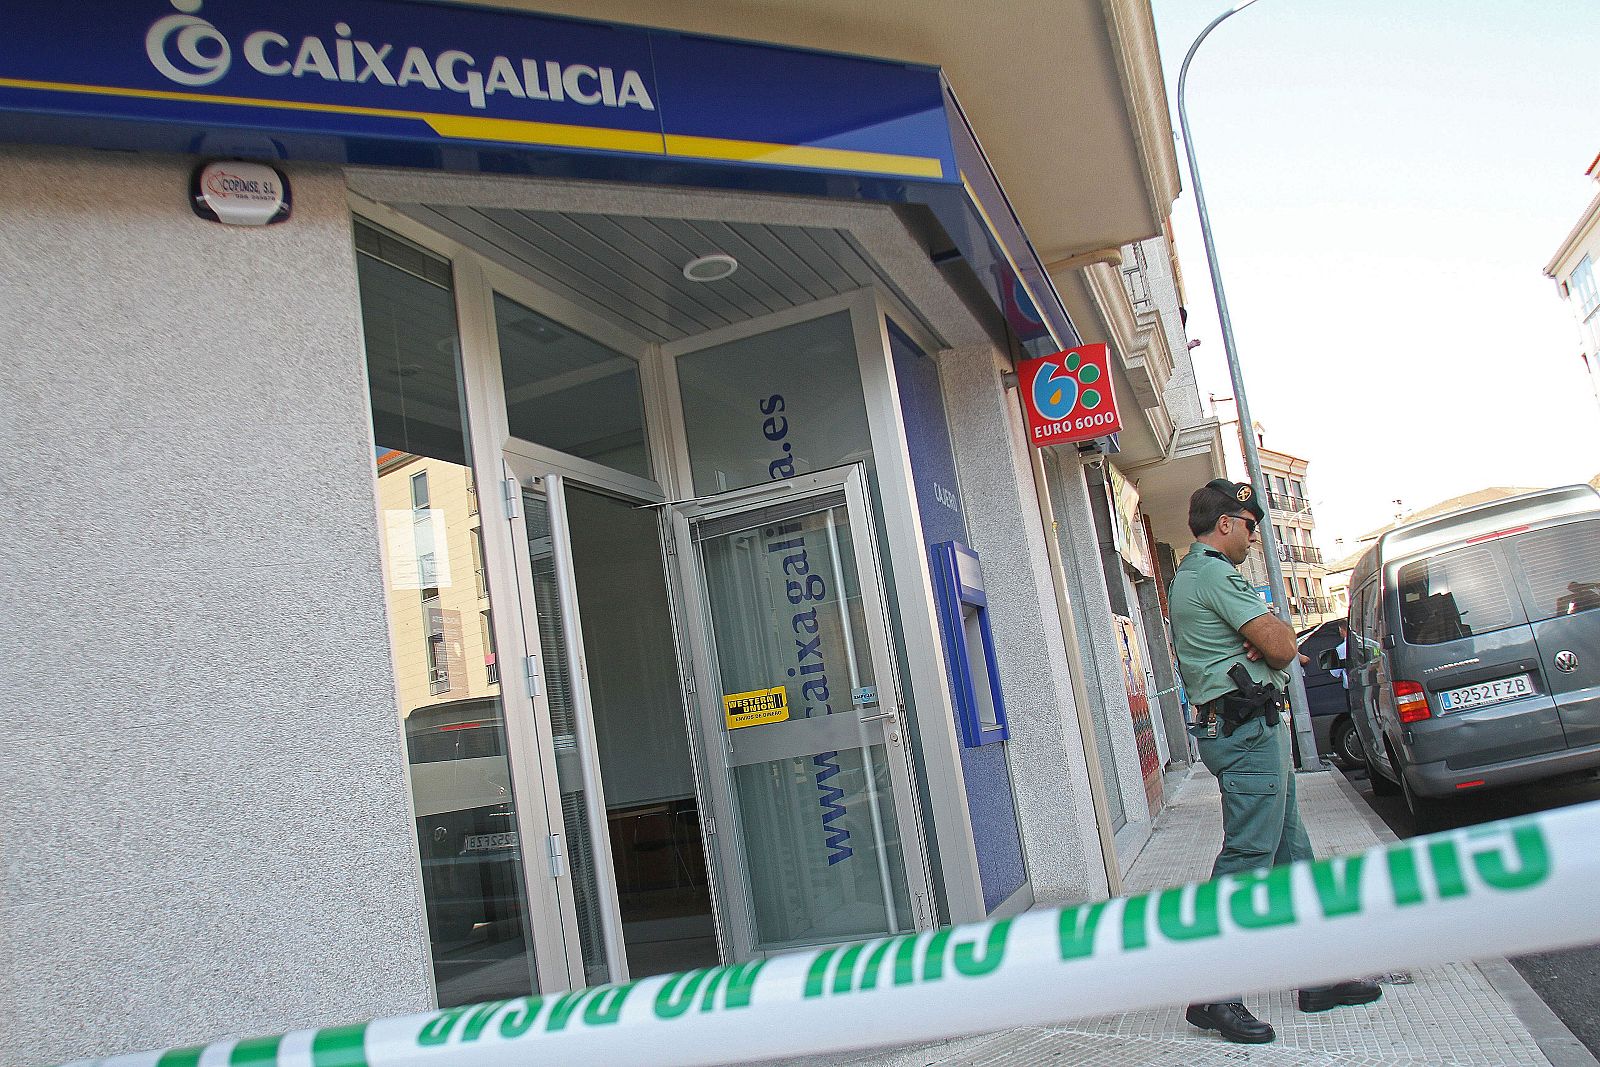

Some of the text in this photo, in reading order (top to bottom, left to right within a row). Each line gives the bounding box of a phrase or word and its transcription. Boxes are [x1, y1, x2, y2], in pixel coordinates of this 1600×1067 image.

[1034, 411, 1115, 439] EURO 6000
[729, 695, 774, 709] WESTERN
[1451, 678, 1527, 705] 3252FZB
[743, 702, 775, 713] UNION
[1058, 822, 1552, 961] GUARDIA
[804, 918, 1014, 998] CIVIL
[654, 960, 768, 1020] NO
